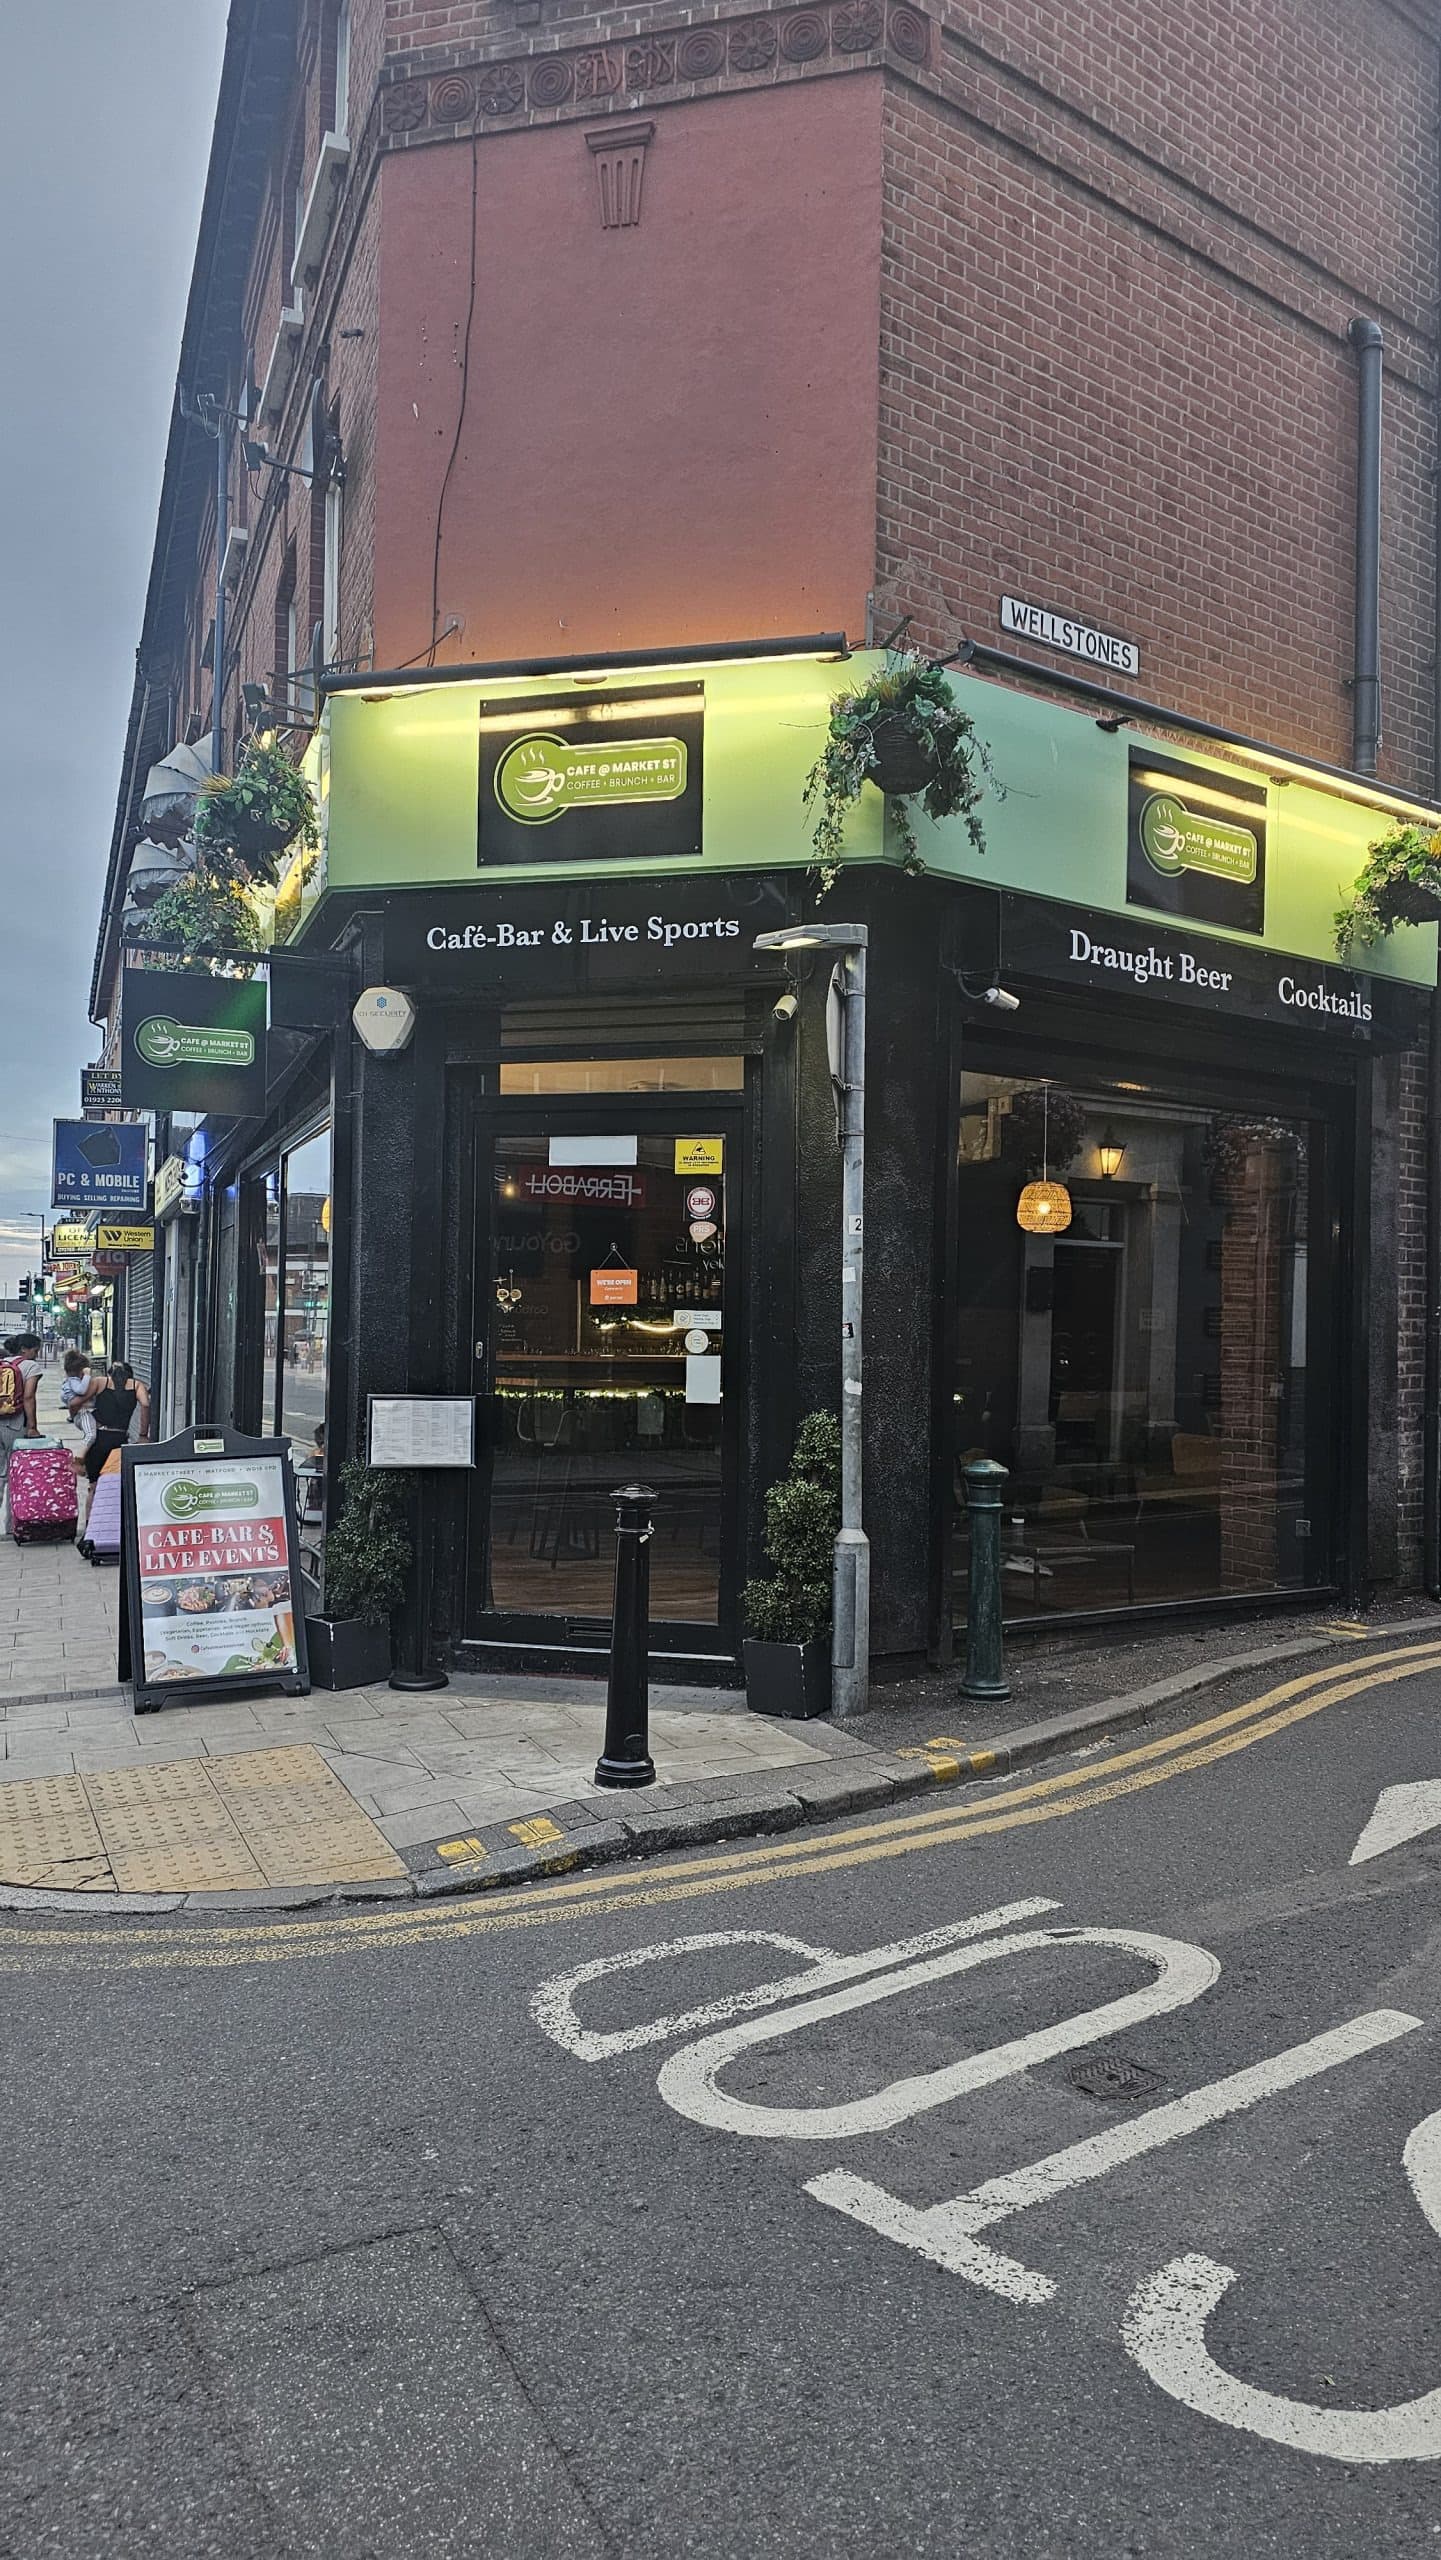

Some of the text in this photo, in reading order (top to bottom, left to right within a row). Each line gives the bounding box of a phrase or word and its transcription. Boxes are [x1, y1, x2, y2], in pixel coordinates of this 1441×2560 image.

[1011, 601, 1132, 669] WELLSTONES
[566, 758, 677, 776] CAFE @ MARKET ST
[566, 774, 675, 791] COFFEE BRUNCH BAR
[1185, 831, 1251, 857] CAFE @ MARKET ST
[1185, 845, 1250, 870] COFFEE BRUNCH BAR
[426, 916, 740, 950] Café-Bar & Live Sports
[1069, 929, 1233, 992] Draught Beer
[1278, 977, 1372, 1021] Cocktails
[208, 1048, 231, 1056] BRUNCH
[209, 1039, 238, 1048] MARKET
[58, 1172, 140, 1188] PC & MOBILE
[57, 1193, 80, 1201] BUYING
[110, 1195, 140, 1203] REPAIRING
[123, 1230, 151, 1238] Western
[855, 1217, 862, 1231] 2
[148, 1524, 274, 1548] CAFE-BAR &
[145, 1545, 280, 1571] LIVE EVENTS
